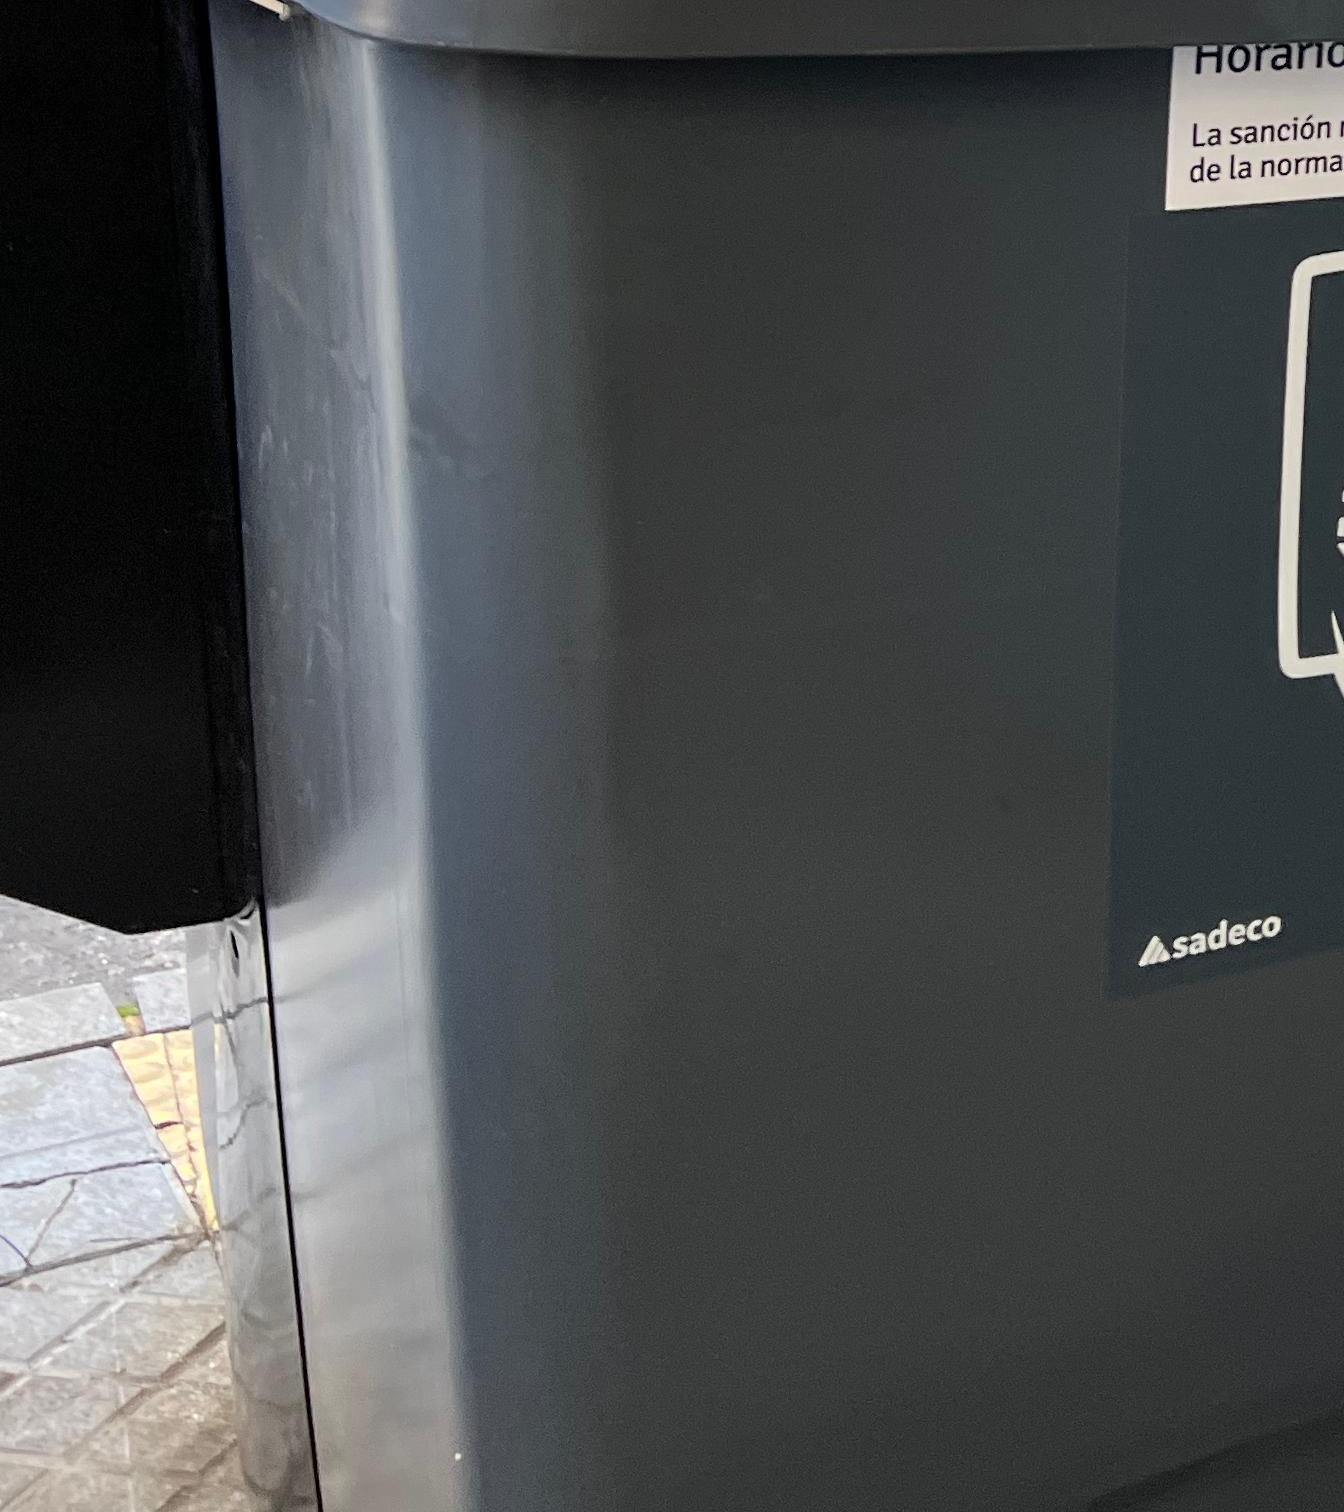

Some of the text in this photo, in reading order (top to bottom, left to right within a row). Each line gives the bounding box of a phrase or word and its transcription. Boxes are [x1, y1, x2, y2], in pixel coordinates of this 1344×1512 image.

[1192, 122, 1222, 147] La
[1229, 114, 1331, 144] sanción
[1190, 157, 1221, 183] de
[1230, 154, 1252, 180] la
[1171, 914, 1283, 960] sadeco
